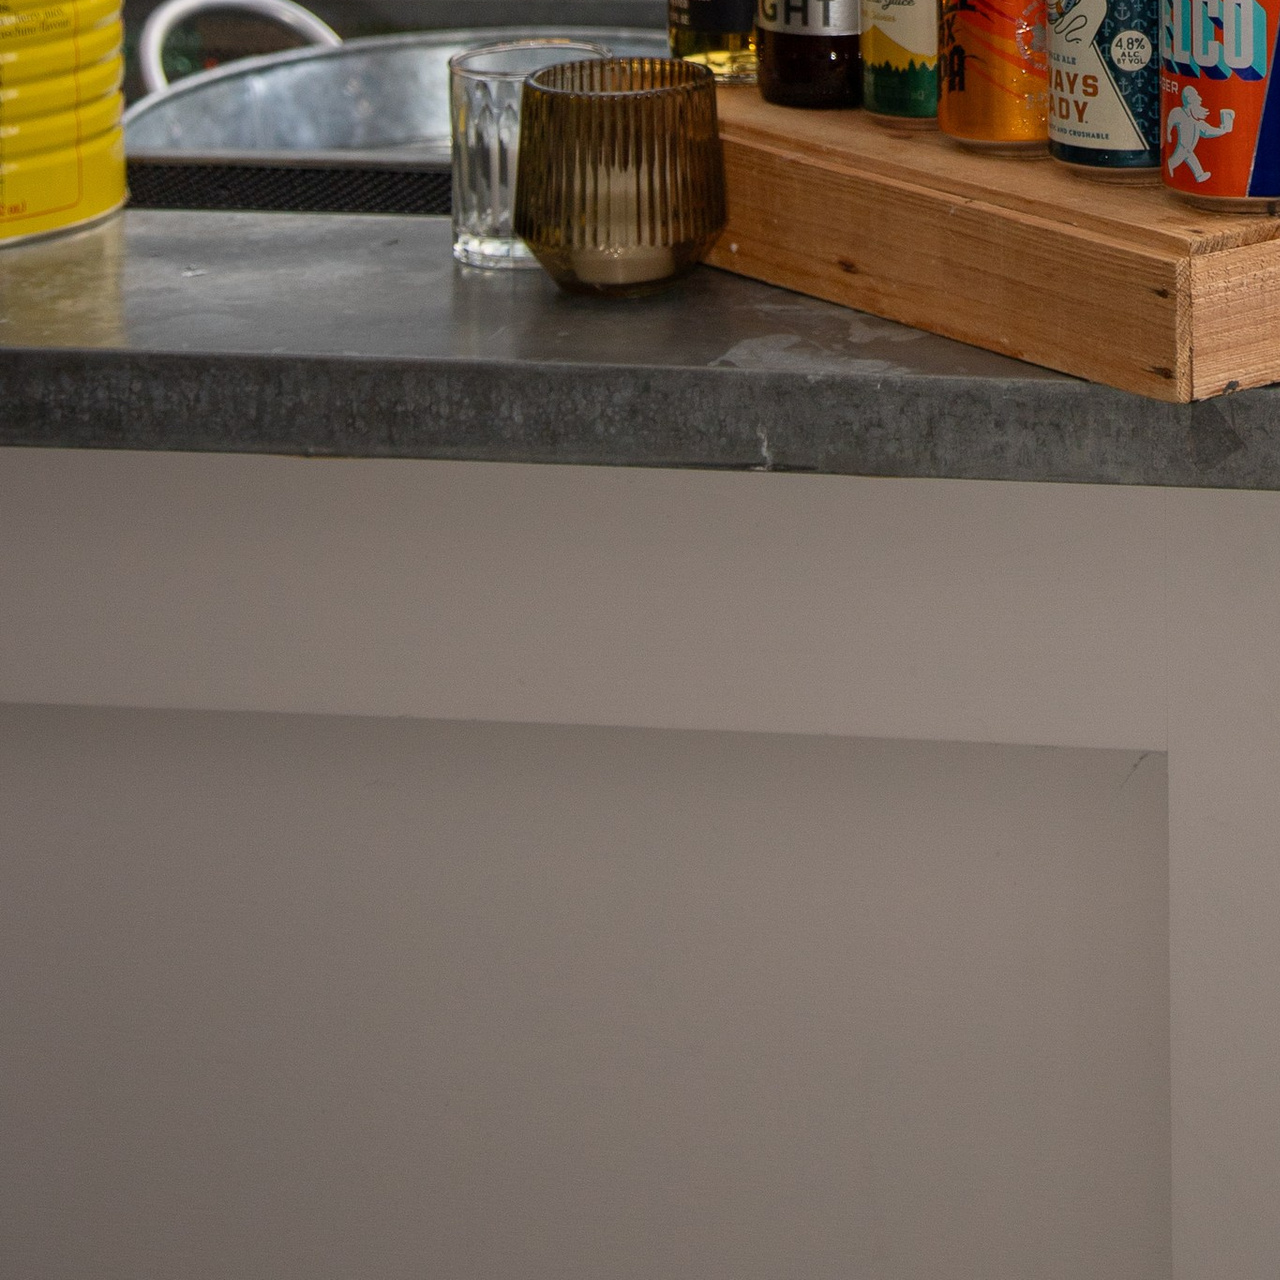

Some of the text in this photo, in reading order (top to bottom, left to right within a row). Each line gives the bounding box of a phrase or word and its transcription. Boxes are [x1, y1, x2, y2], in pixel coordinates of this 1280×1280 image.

[1115, 37, 1145, 51] 4.8%
[1062, 53, 1077, 65] ALE
[1050, 67, 1099, 97] AYS
[1069, 129, 1110, 140] CRUSHABLE
